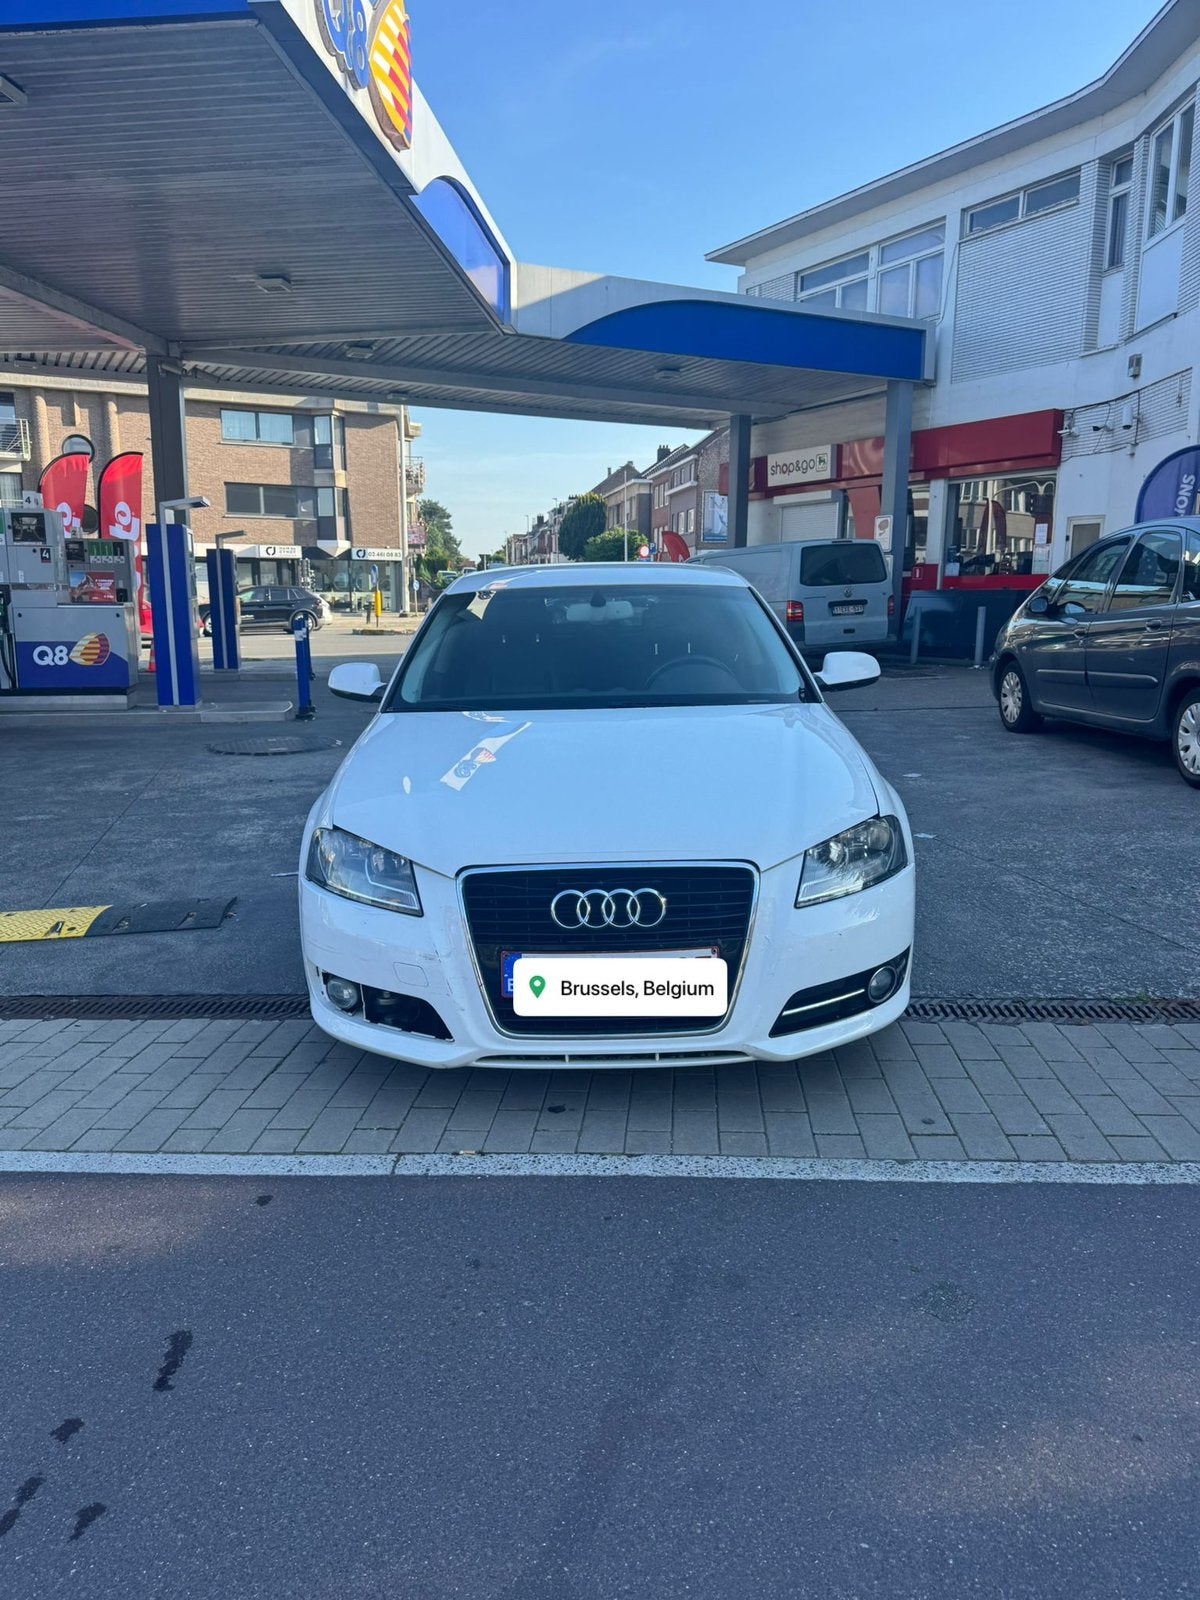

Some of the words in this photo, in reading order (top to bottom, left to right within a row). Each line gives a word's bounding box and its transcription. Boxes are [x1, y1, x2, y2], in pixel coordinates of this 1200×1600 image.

[770, 458, 816, 476] shop&go
[1174, 473, 1196, 517] IONS
[42, 550, 49, 558] 4
[33, 645, 68, 666] Q8
